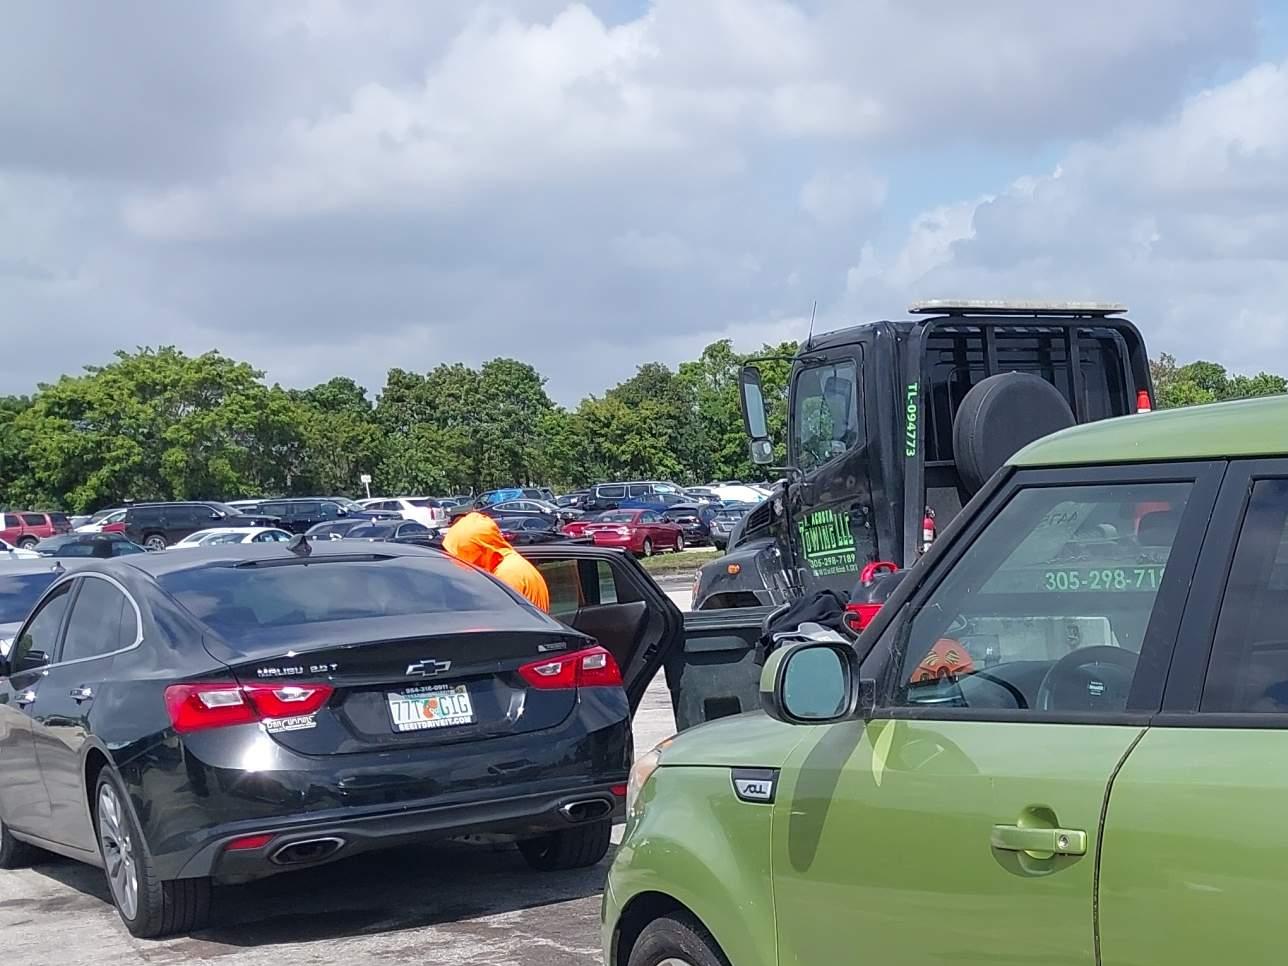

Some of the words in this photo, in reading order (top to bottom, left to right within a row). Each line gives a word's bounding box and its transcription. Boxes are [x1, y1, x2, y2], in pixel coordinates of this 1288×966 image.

[906, 382, 918, 457] TL-094773
[1045, 568, 1165, 590] 305-298-71
[392, 699, 421, 721] 77T
[439, 694, 469, 716] GIG
